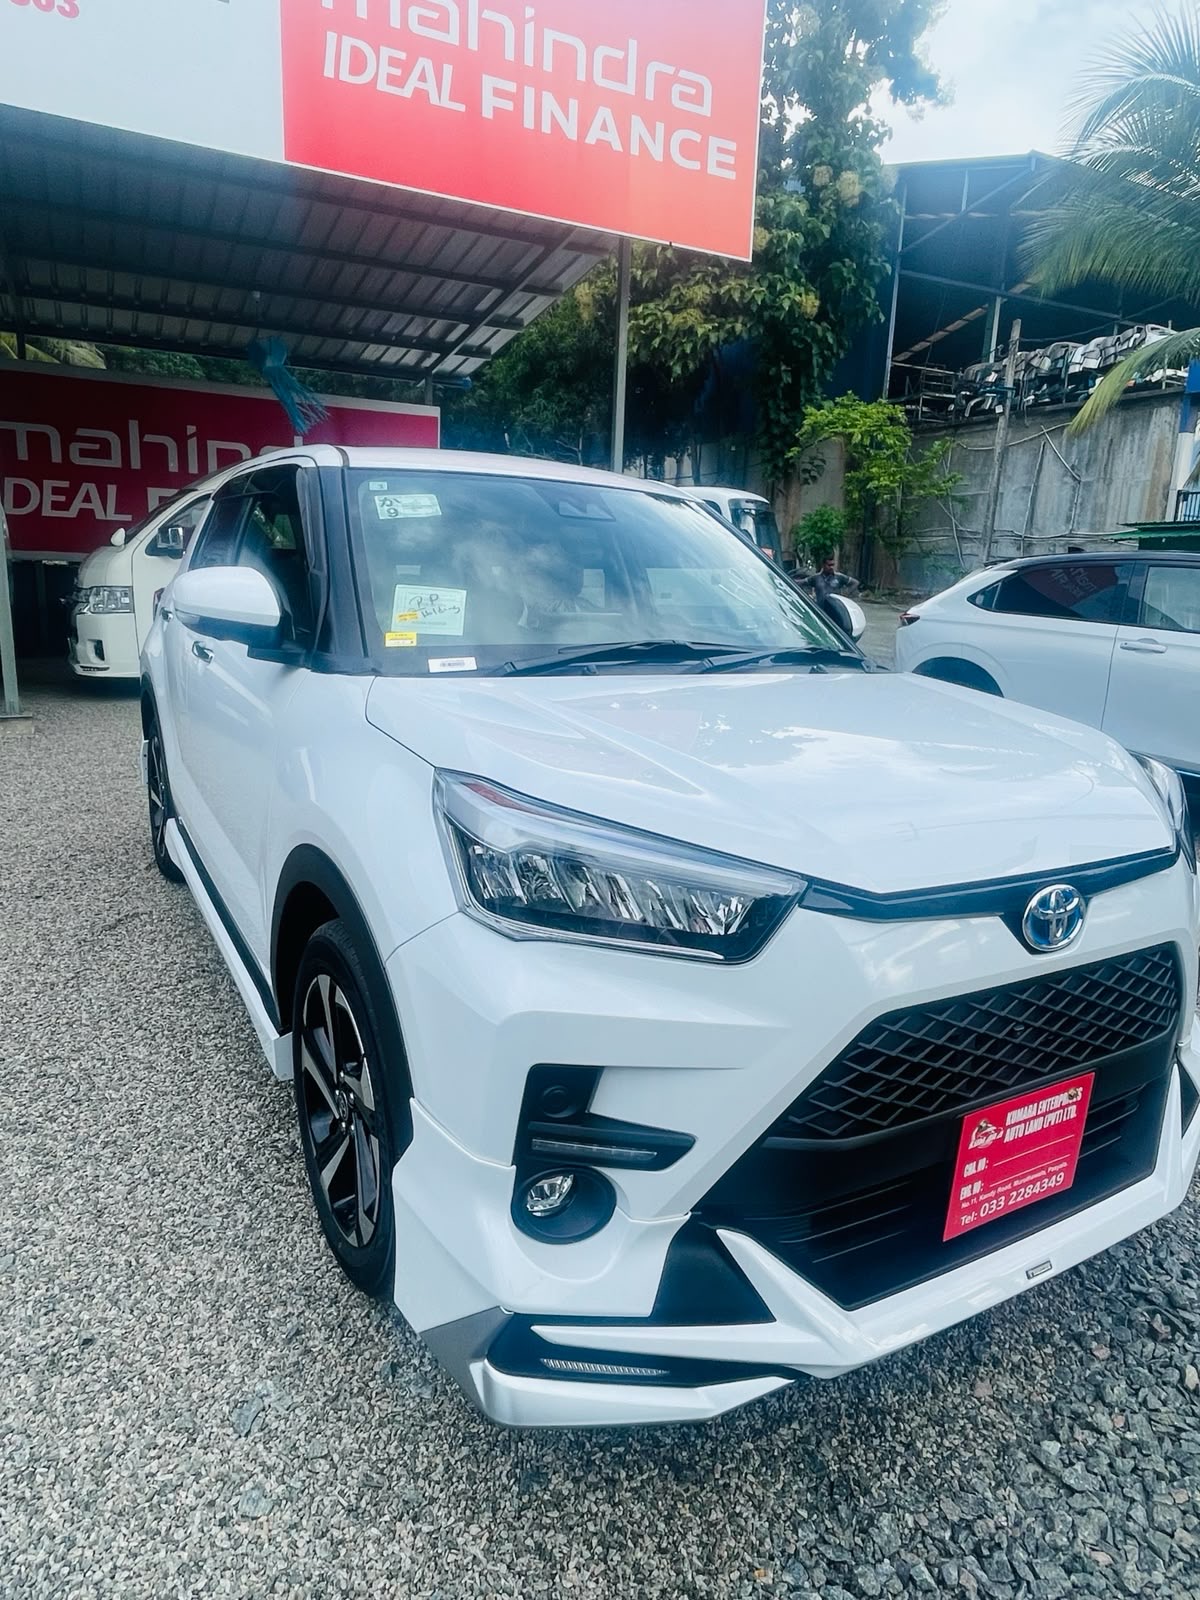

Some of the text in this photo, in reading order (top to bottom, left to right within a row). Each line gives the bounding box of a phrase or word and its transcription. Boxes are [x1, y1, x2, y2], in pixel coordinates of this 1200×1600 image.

[323, 31, 737, 180] IDEAL FINANCE
[0, 419, 304, 474] mahin
[3, 477, 133, 521] DEAL
[1003, 1122, 1025, 1143] AUTO
[1024, 1116, 1044, 1135] LAND
[1043, 1109, 1064, 1128] (PVT)
[1005, 1102, 1038, 1126] KUMARA
[960, 1172, 1065, 1226] Tel: 033 2284349
[978, 1190, 996, 1202] Kandy
